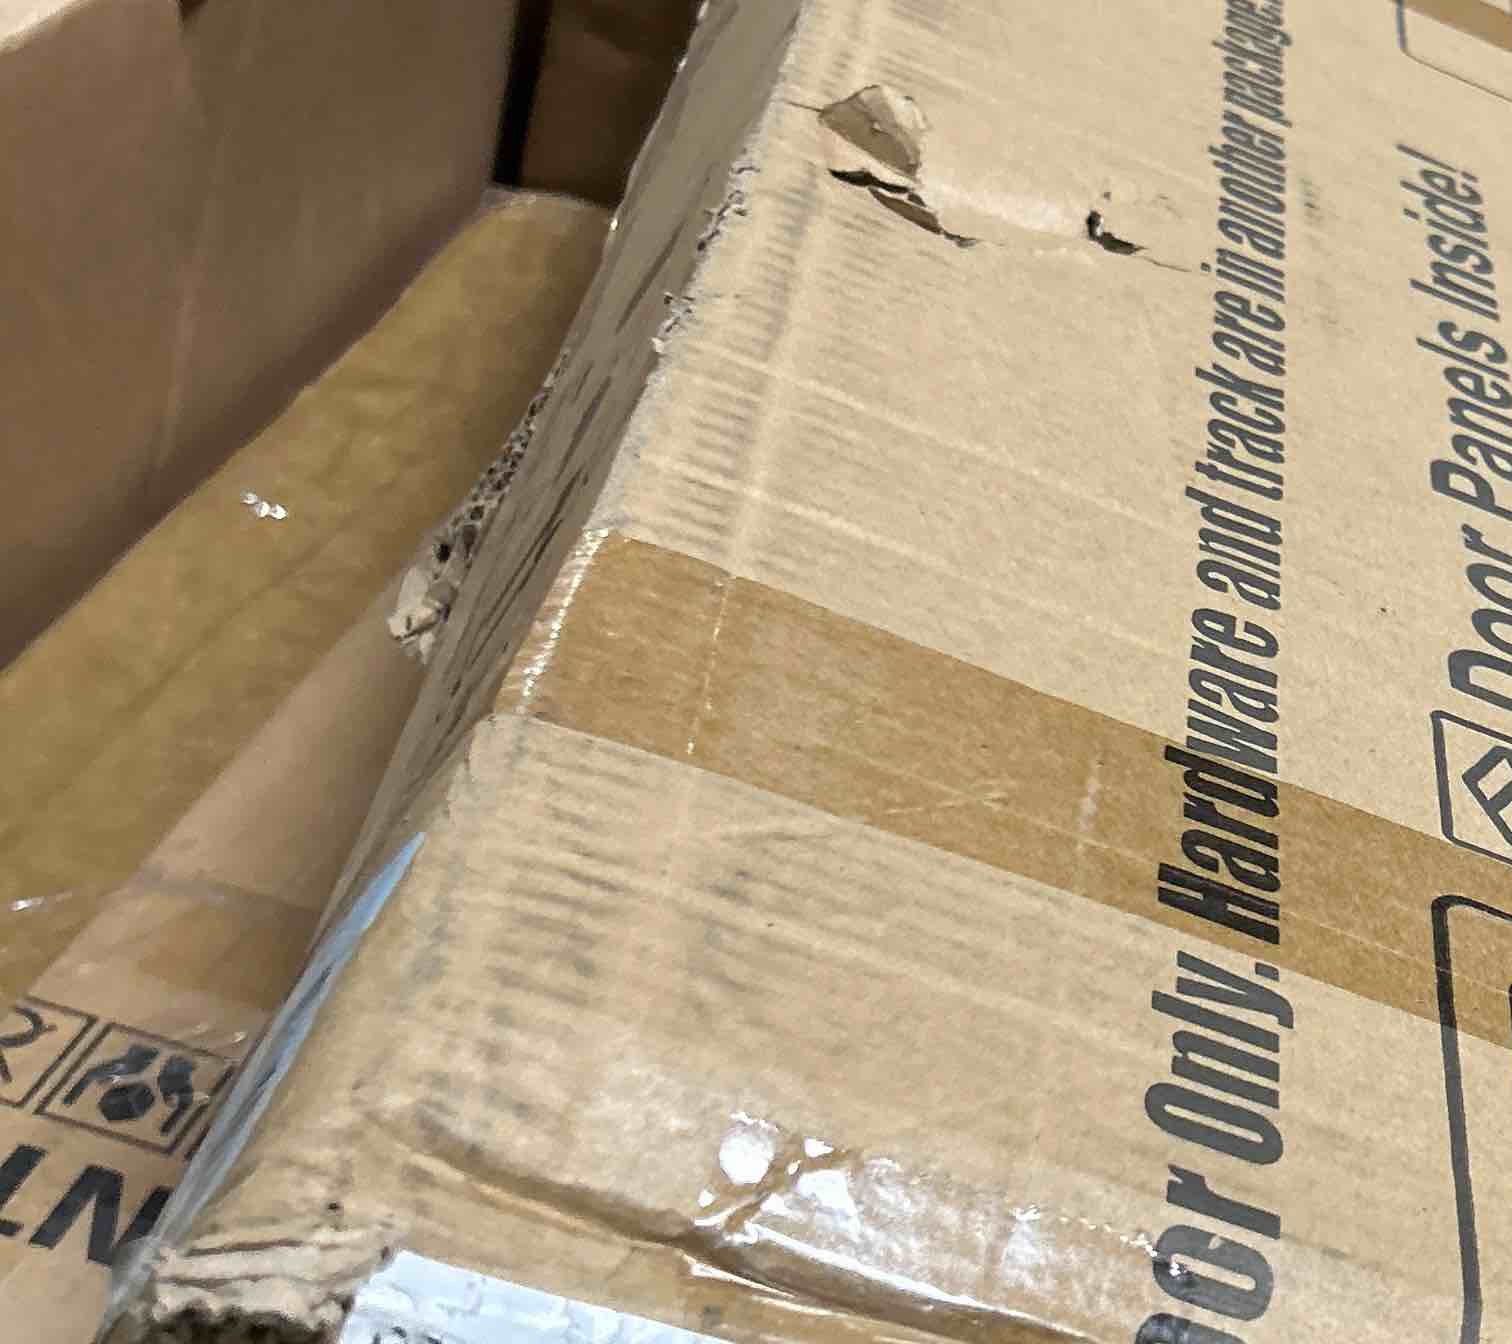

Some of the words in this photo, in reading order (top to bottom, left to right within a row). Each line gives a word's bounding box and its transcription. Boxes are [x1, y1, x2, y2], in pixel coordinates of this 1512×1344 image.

[1207, 121, 1288, 260] another
[1395, 144, 1498, 323] Inside!
[1201, 261, 1287, 304] in
[1212, 287, 1287, 378] are
[1193, 366, 1287, 502] track
[1184, 486, 1284, 611] and
[1157, 606, 1282, 945] Hardware
[1144, 951, 1294, 1166] Only.
